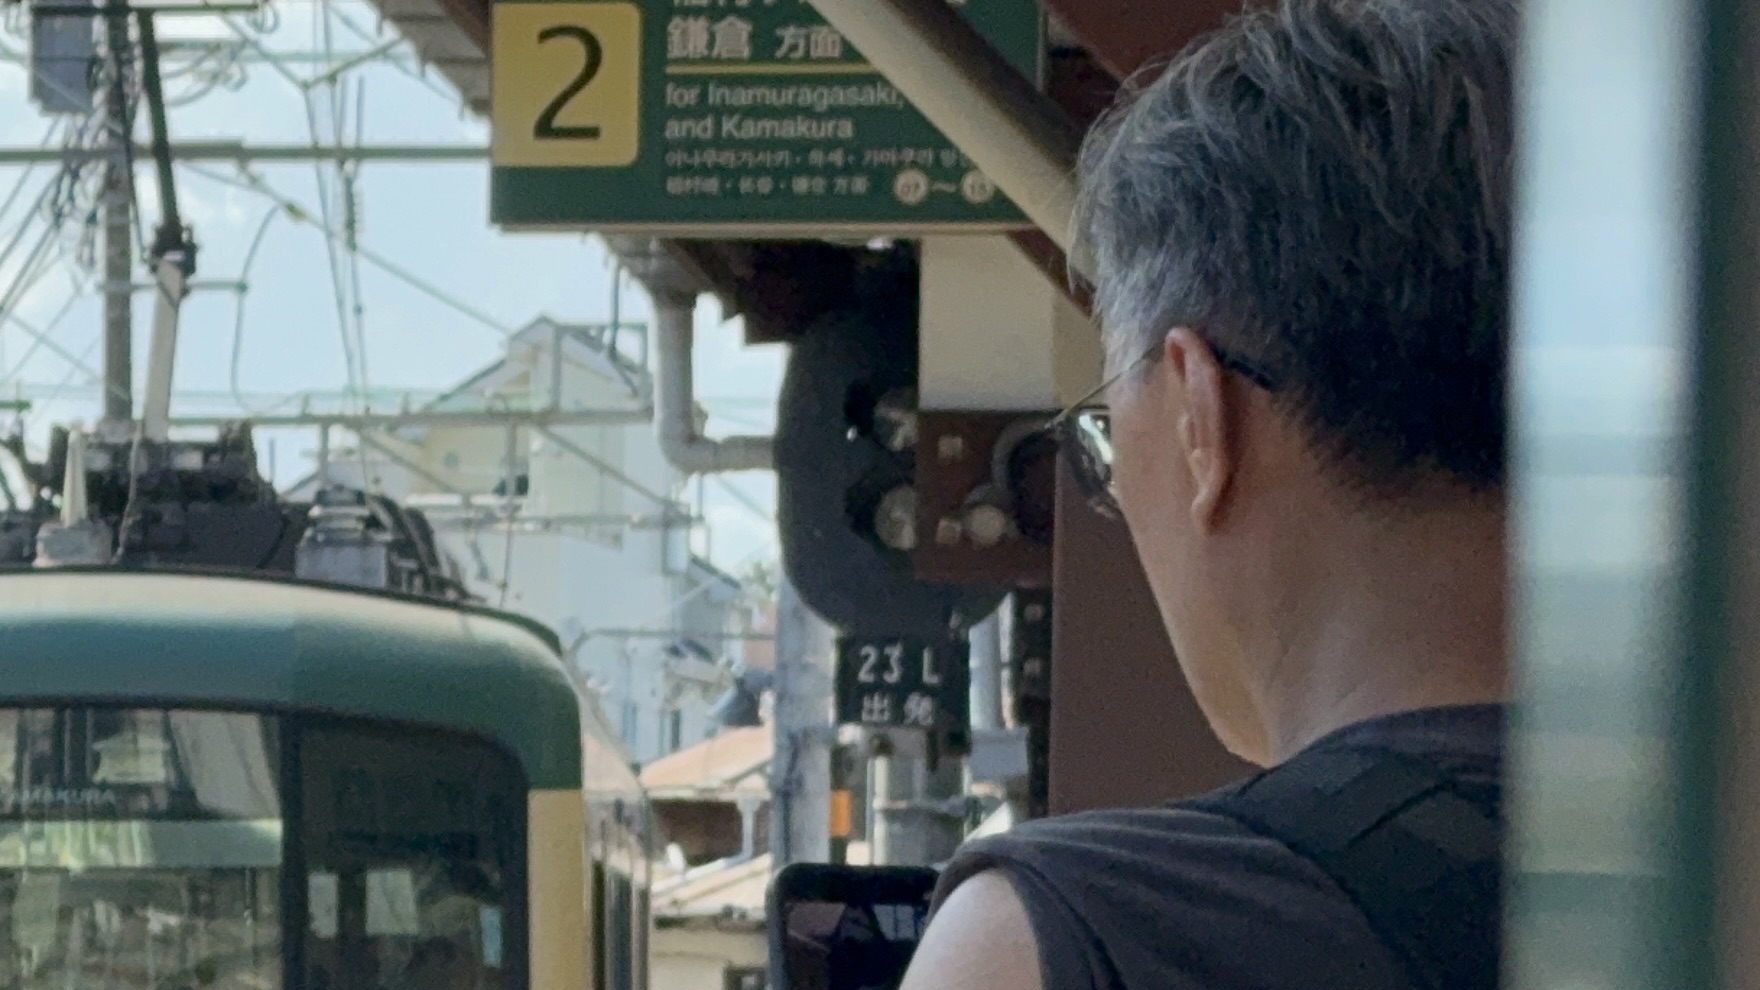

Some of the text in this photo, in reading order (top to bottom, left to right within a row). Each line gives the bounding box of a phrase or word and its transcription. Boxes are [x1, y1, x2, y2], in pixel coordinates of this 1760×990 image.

[666, 15, 843, 60] 鎌倉 方面
[532, 25, 604, 141] 2
[665, 82, 701, 106] for
[665, 114, 854, 139] and Kamakura
